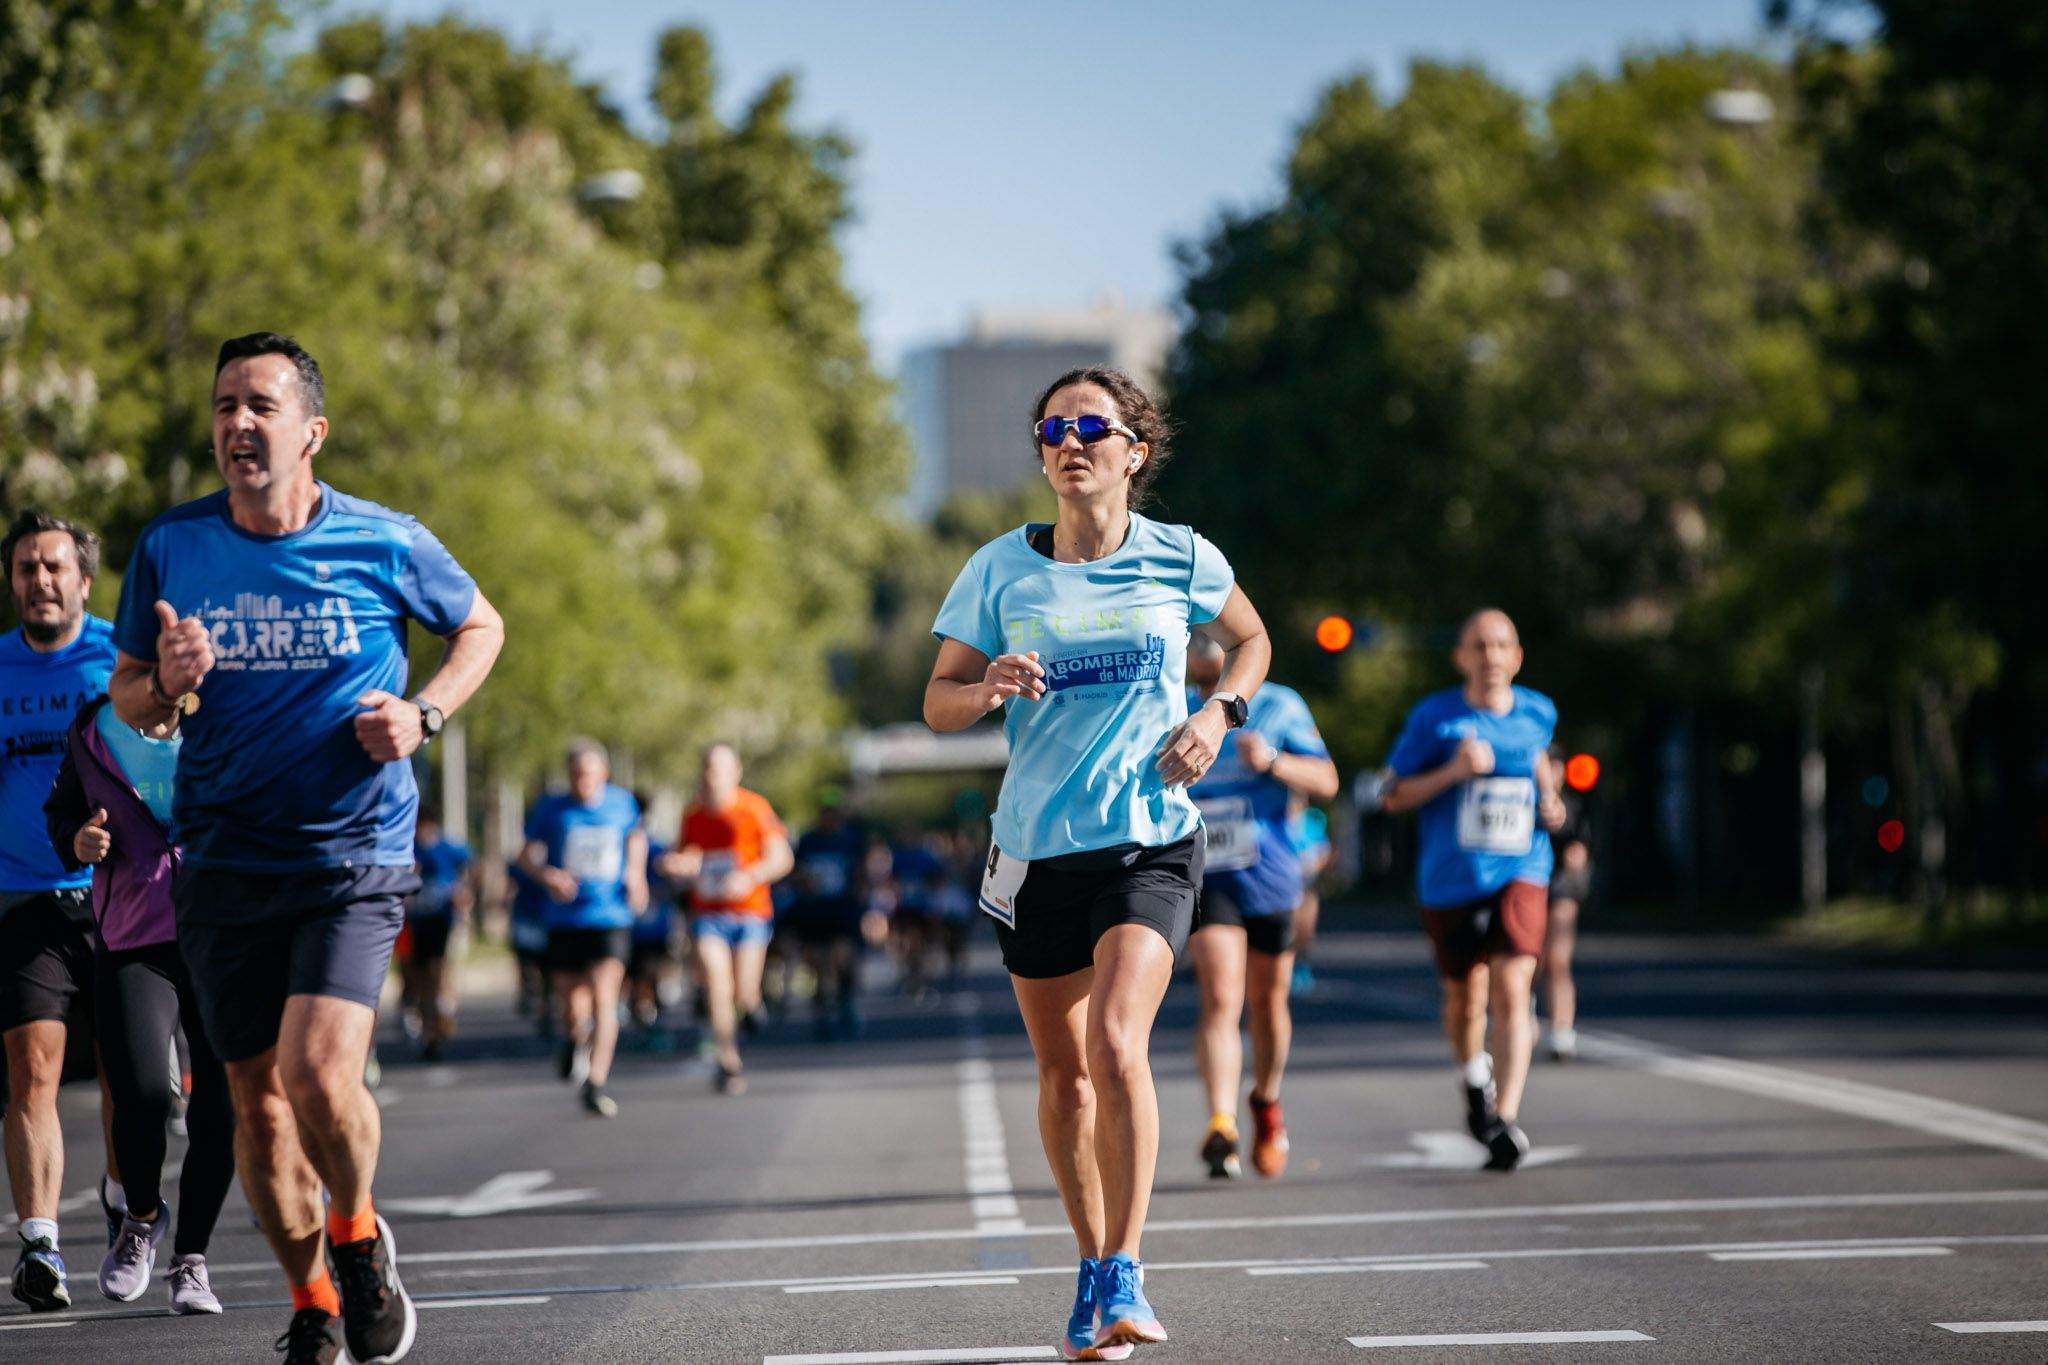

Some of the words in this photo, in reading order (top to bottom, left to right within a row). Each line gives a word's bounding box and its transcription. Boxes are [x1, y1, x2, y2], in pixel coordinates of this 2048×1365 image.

[1056, 651, 1161, 674] BOMBEROS
[1100, 669, 1114, 682] de
[1117, 664, 1160, 681] MADRID
